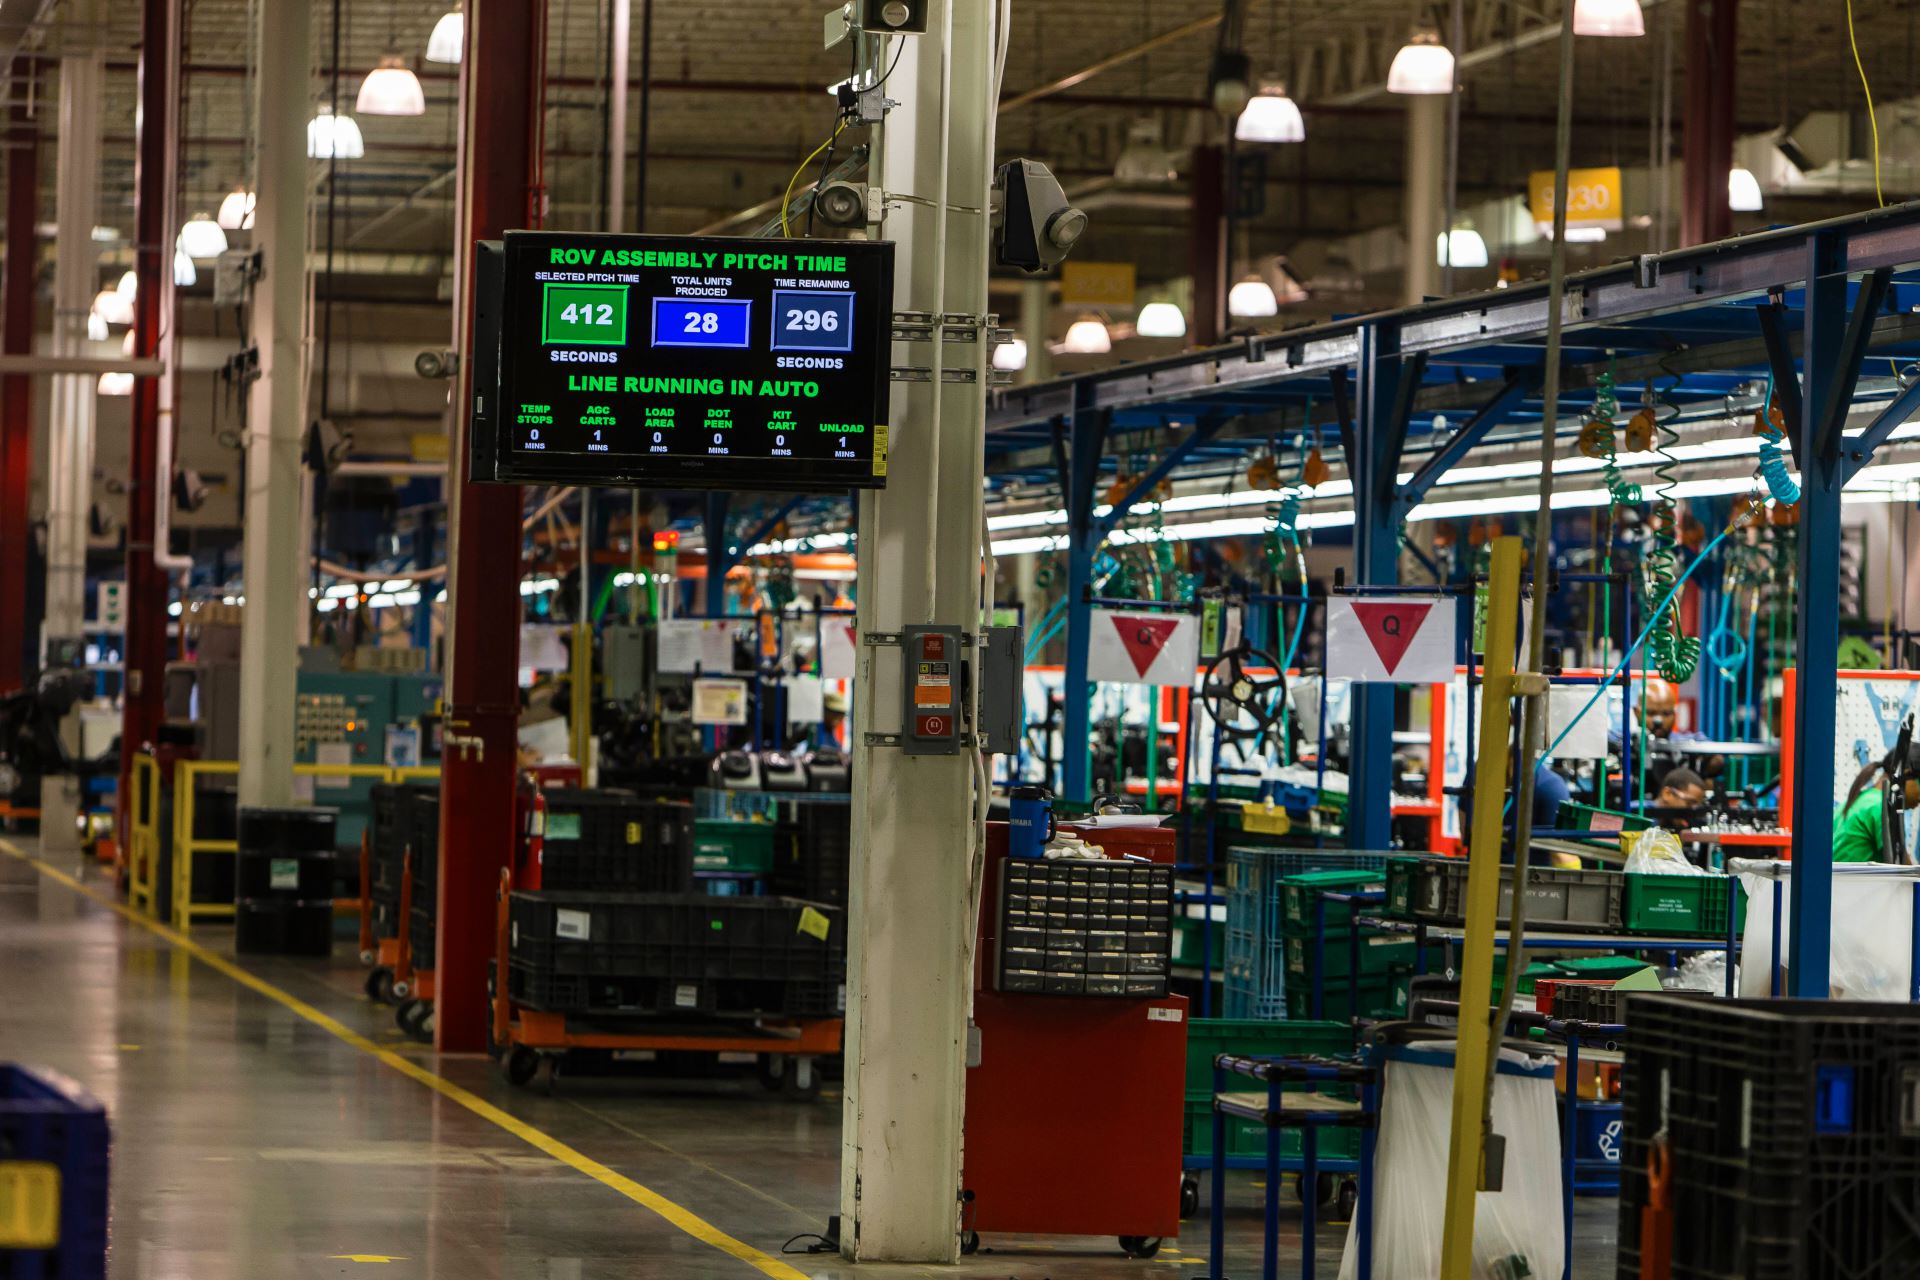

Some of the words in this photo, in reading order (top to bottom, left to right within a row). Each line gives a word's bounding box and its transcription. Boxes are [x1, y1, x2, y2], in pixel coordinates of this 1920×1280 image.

[551, 249, 595, 264] ROV
[601, 250, 717, 268] ASSEMBLY
[724, 254, 787, 270] PITCH
[795, 256, 846, 272] TIME
[535, 272, 585, 281] SELECTED
[587, 273, 615, 282] PITCH
[617, 274, 639, 283] TIME
[671, 276, 702, 285] TOTAL
[704, 277, 732, 285] UNITS
[774, 279, 796, 287] TIME
[799, 279, 849, 288] REMAINING
[676, 287, 727, 296] PRODUCED
[561, 304, 612, 324] 412
[684, 312, 718, 333] 28
[786, 310, 837, 331] 296
[551, 351, 617, 363] SECONDS
[777, 357, 843, 369] SECONDS
[569, 376, 617, 391] LINE
[625, 377, 723, 394] RUNNING
[731, 380, 753, 395] IN
[759, 381, 818, 397] AUTO
[521, 405, 550, 413] TEMP
[587, 406, 609, 414] AGC
[646, 408, 674, 416] LOAD
[708, 409, 730, 417] DOT
[518, 415, 553, 424] STOPS
[773, 411, 792, 419] KIT
[580, 416, 616, 425] CARTS
[645, 419, 674, 427] AREA
[704, 420, 732, 428] PEEN
[767, 422, 797, 430] CART
[820, 424, 864, 432] UNLOAD
[531, 429, 539, 440] 0
[594, 430, 600, 441] 1
[653, 432, 661, 443] 0
[714, 433, 722, 444] 0
[776, 435, 784, 446] 0
[839, 437, 846, 447] 1
[1382, 614, 1399, 636] Q
